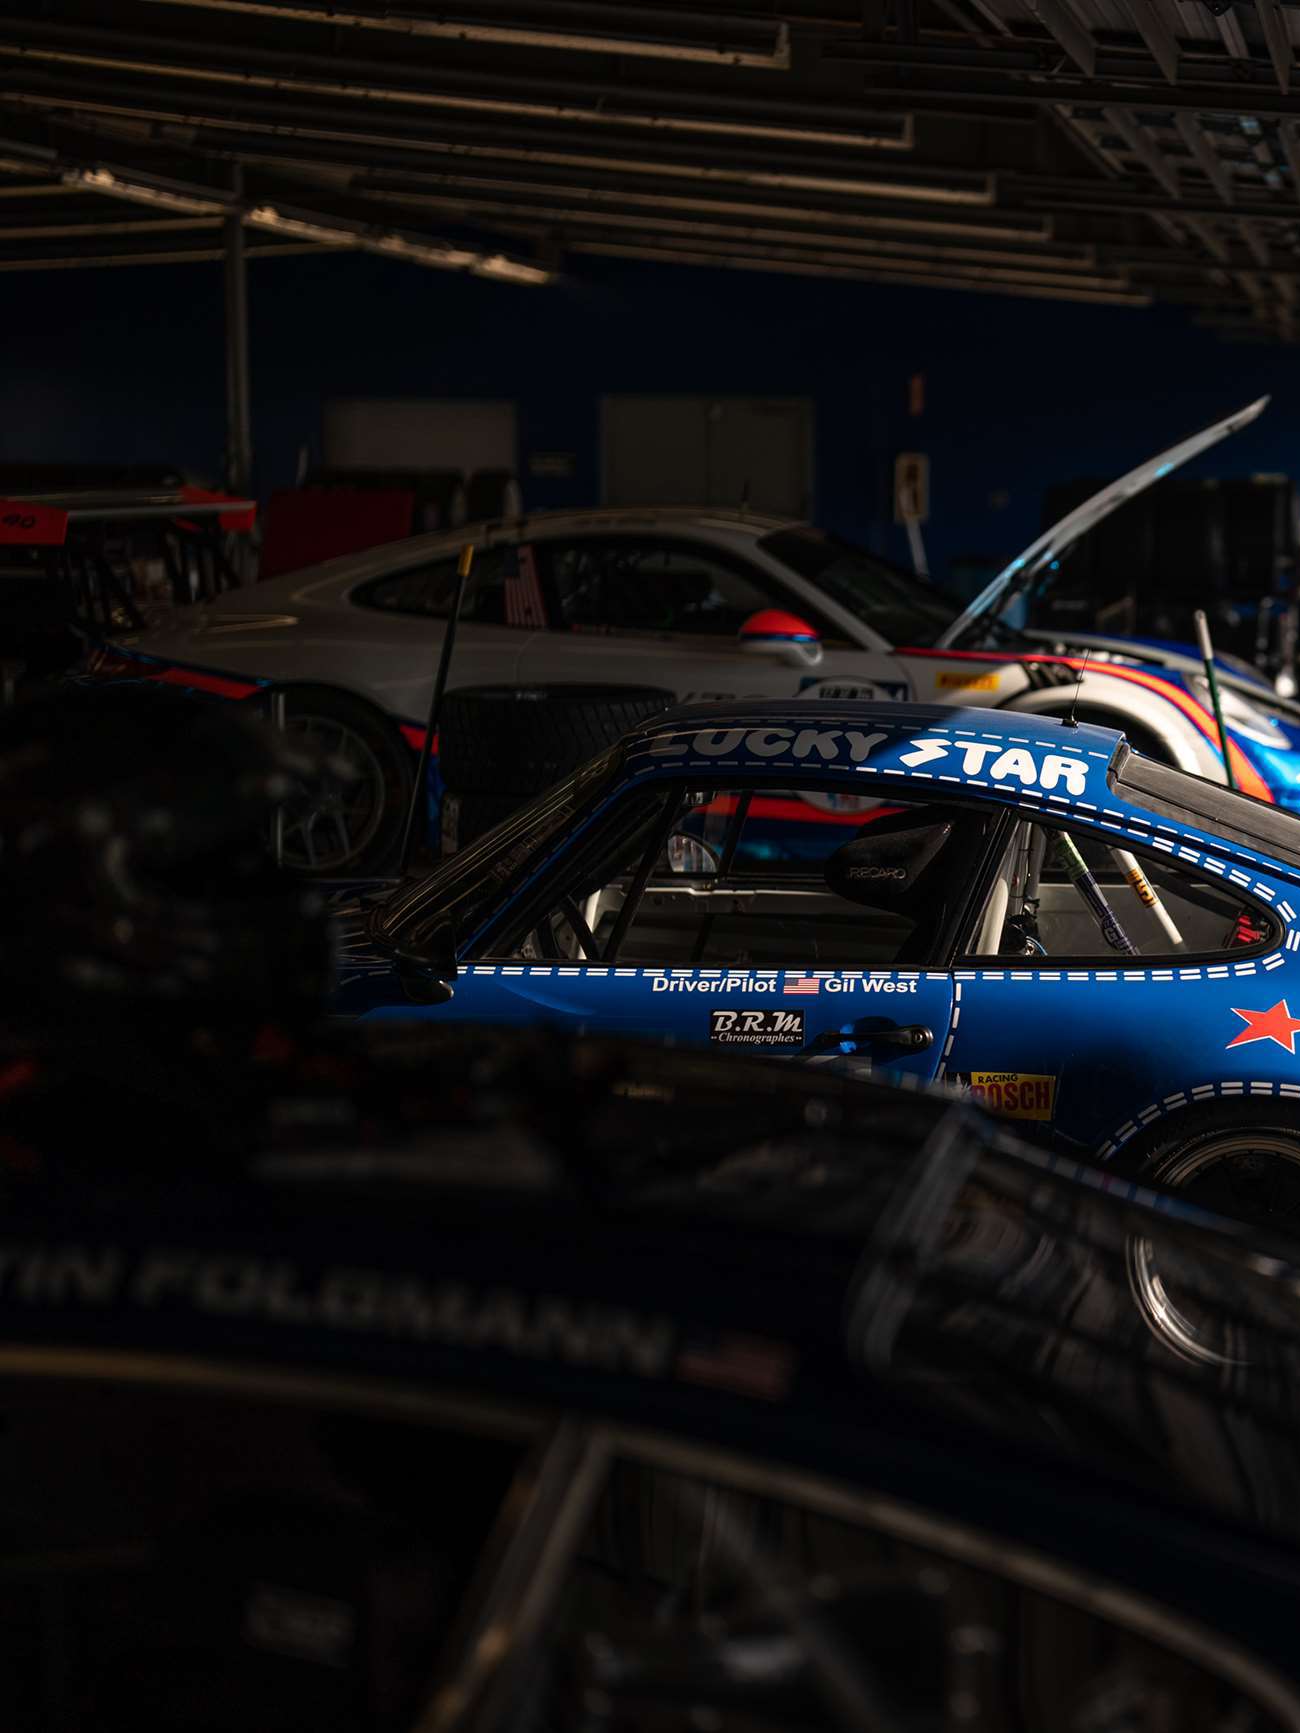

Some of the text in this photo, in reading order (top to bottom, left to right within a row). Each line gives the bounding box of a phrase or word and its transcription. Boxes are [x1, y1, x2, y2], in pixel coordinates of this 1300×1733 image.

[648, 728, 1089, 796] LUCKY STAR
[849, 866, 907, 880] RECARO
[652, 977, 917, 993] Driver/Pilot Gil West
[717, 1031, 796, 1045] Chronographes
[978, 1074, 1018, 1084] RACING
